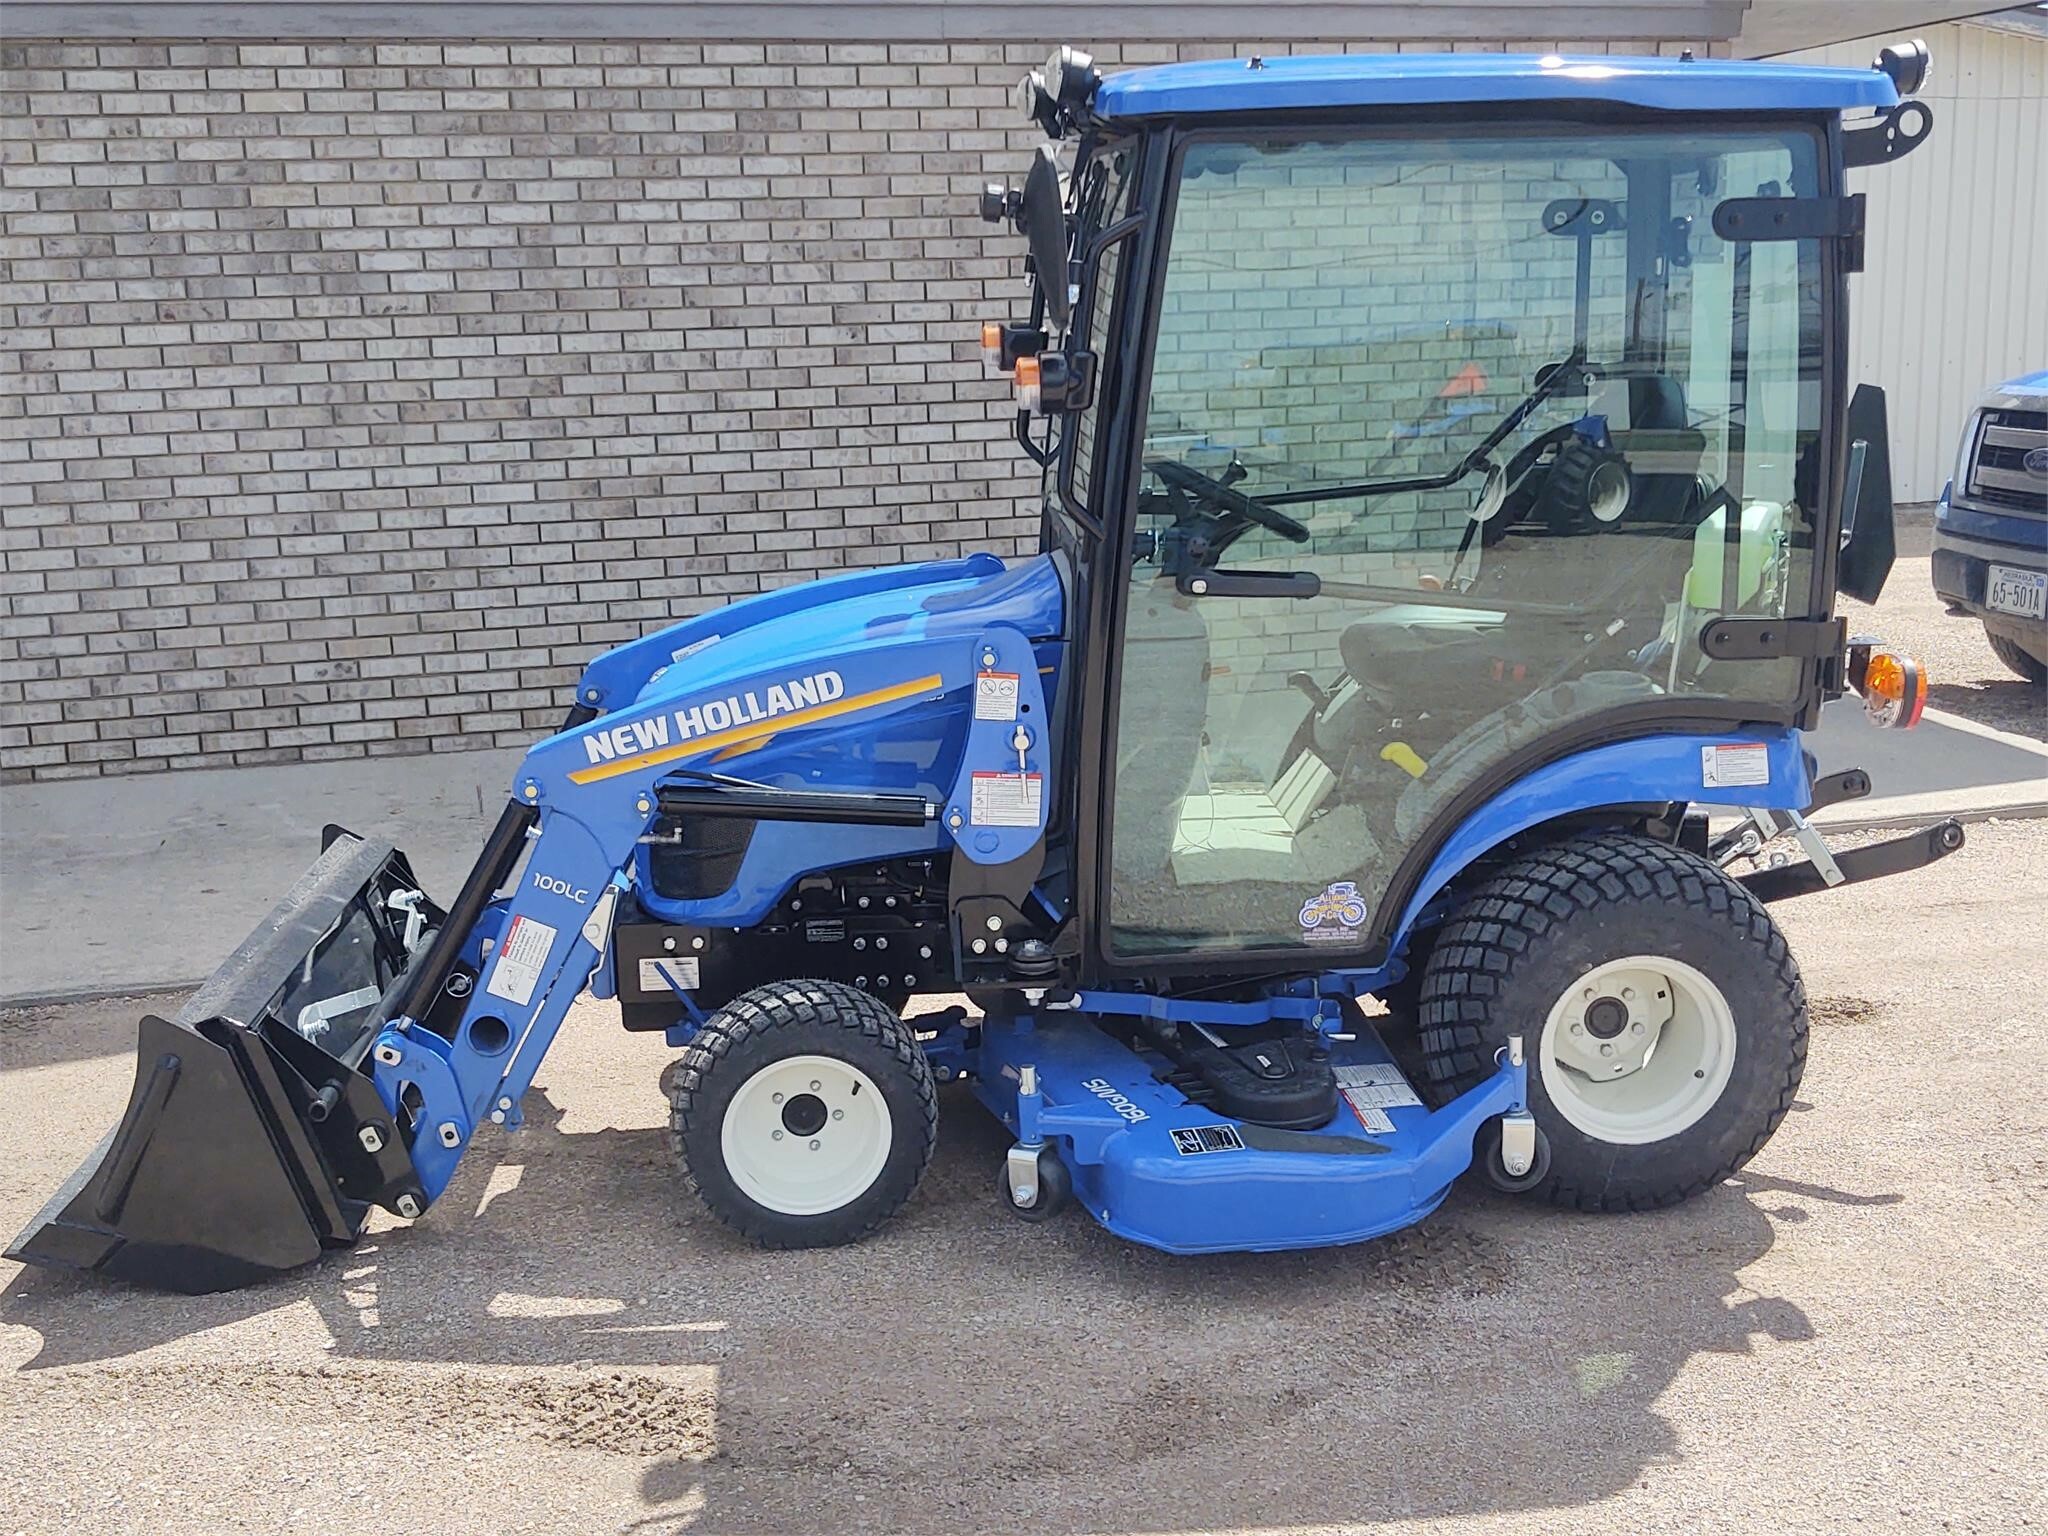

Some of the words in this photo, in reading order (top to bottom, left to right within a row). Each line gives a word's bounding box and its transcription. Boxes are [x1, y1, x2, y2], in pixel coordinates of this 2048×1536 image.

[1993, 582, 2040, 611] 65-501A
[583, 714, 669, 764] NEW
[675, 670, 845, 740] HOLLAND
[534, 872, 589, 904] 100LC
[1081, 1078, 1150, 1124] 160GMS
